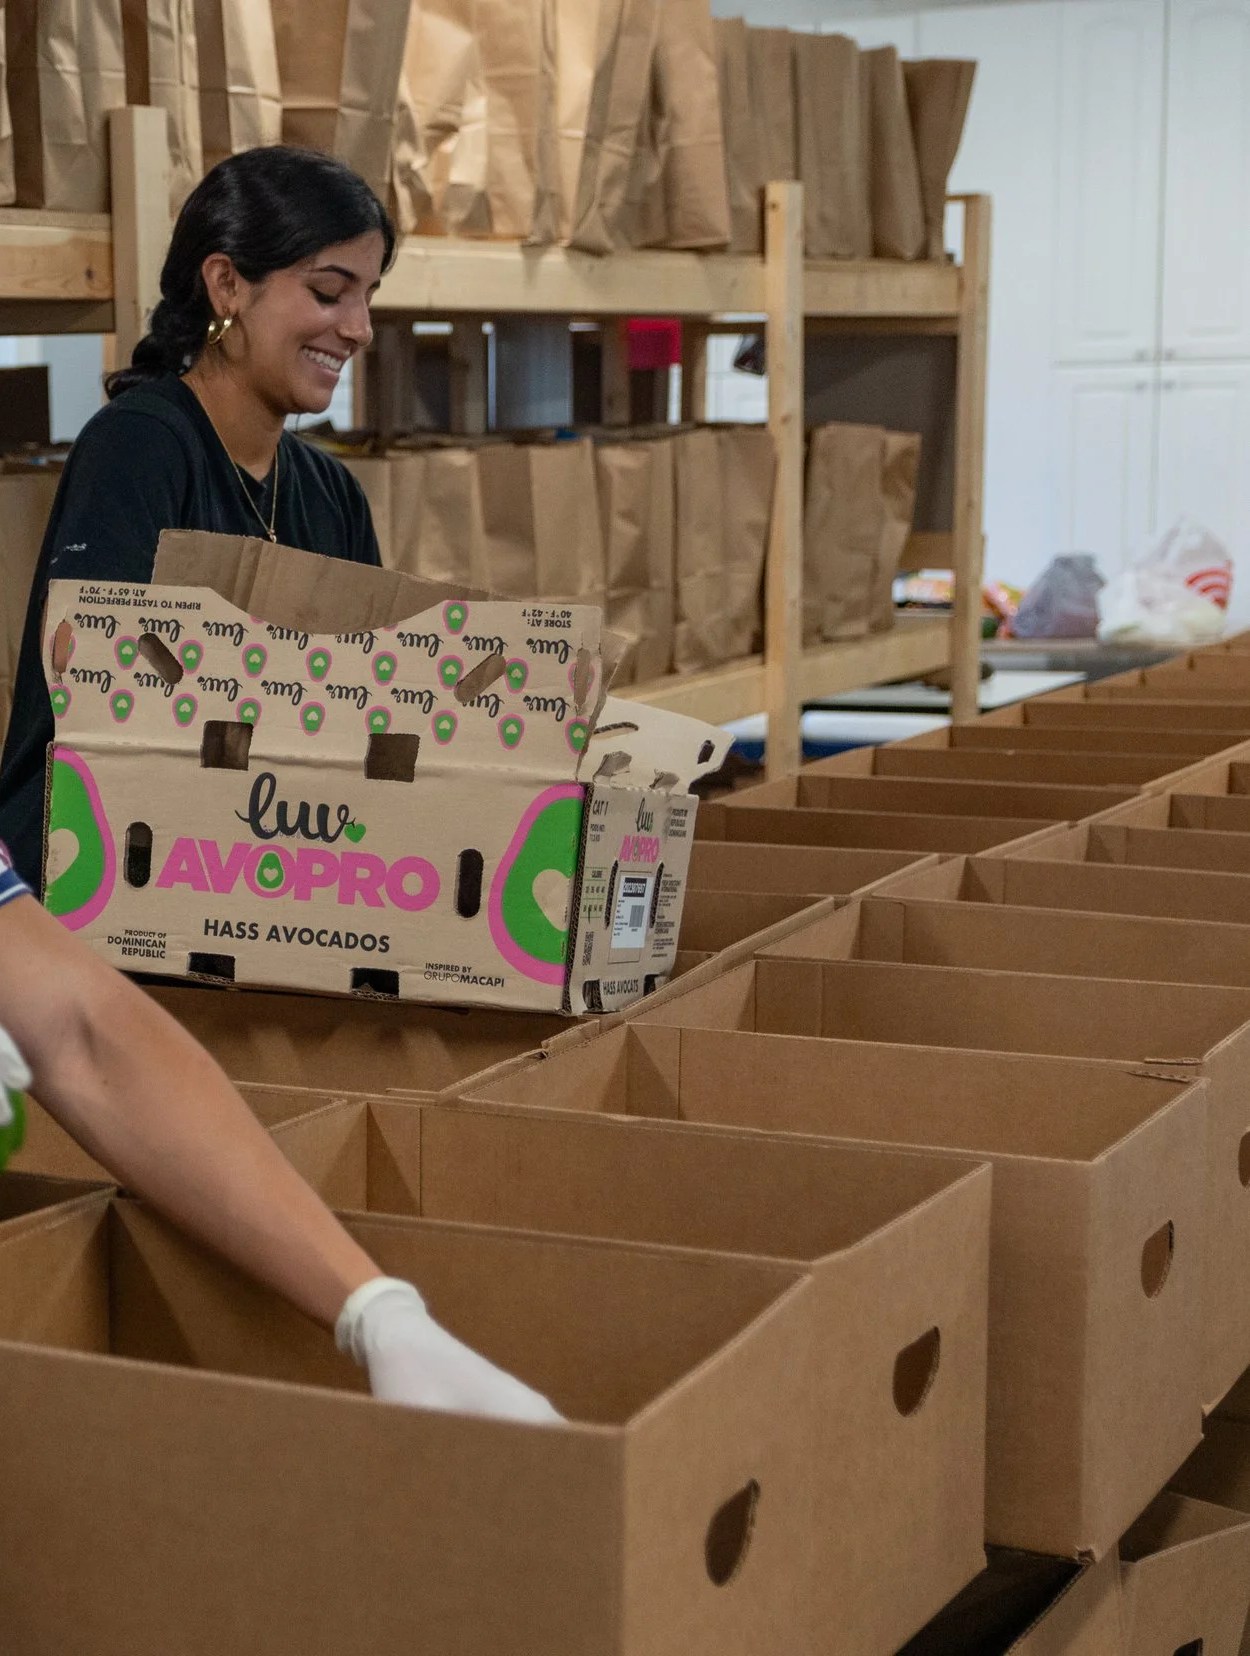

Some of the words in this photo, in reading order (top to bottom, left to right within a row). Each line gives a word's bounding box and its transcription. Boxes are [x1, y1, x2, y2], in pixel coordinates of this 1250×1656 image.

[78, 595, 131, 607] PERFECTION
[132, 589, 147, 598] AT:
[132, 598, 159, 608] TASTE
[160, 600, 173, 609] TO
[174, 601, 202, 611] RIPEN
[78, 614, 121, 639] luv
[141, 618, 185, 643] luv
[205, 622, 249, 646] luv
[526, 618, 543, 628] AT:
[543, 619, 572, 628] STORE
[401, 633, 444, 657] luv
[529, 639, 573, 664] luv
[74, 669, 116, 694] luv
[200, 677, 243, 702] luv
[263, 681, 307, 706] luv
[328, 685, 372, 710] luv
[394, 689, 438, 714] luv
[526, 697, 570, 722] luv
[235, 771, 357, 843] luv
[154, 836, 441, 912] AVOPRO
[107, 935, 167, 949] DOMINICAN
[124, 929, 156, 938] PRODUCT
[203, 918, 260, 941] HASS
[265, 924, 391, 953] AVOCADOS
[121, 946, 166, 959] REPUBLIC
[425, 962, 460, 973] INSPIRED
[461, 966, 472, 974] BY
[602, 980, 616, 995] HASS
